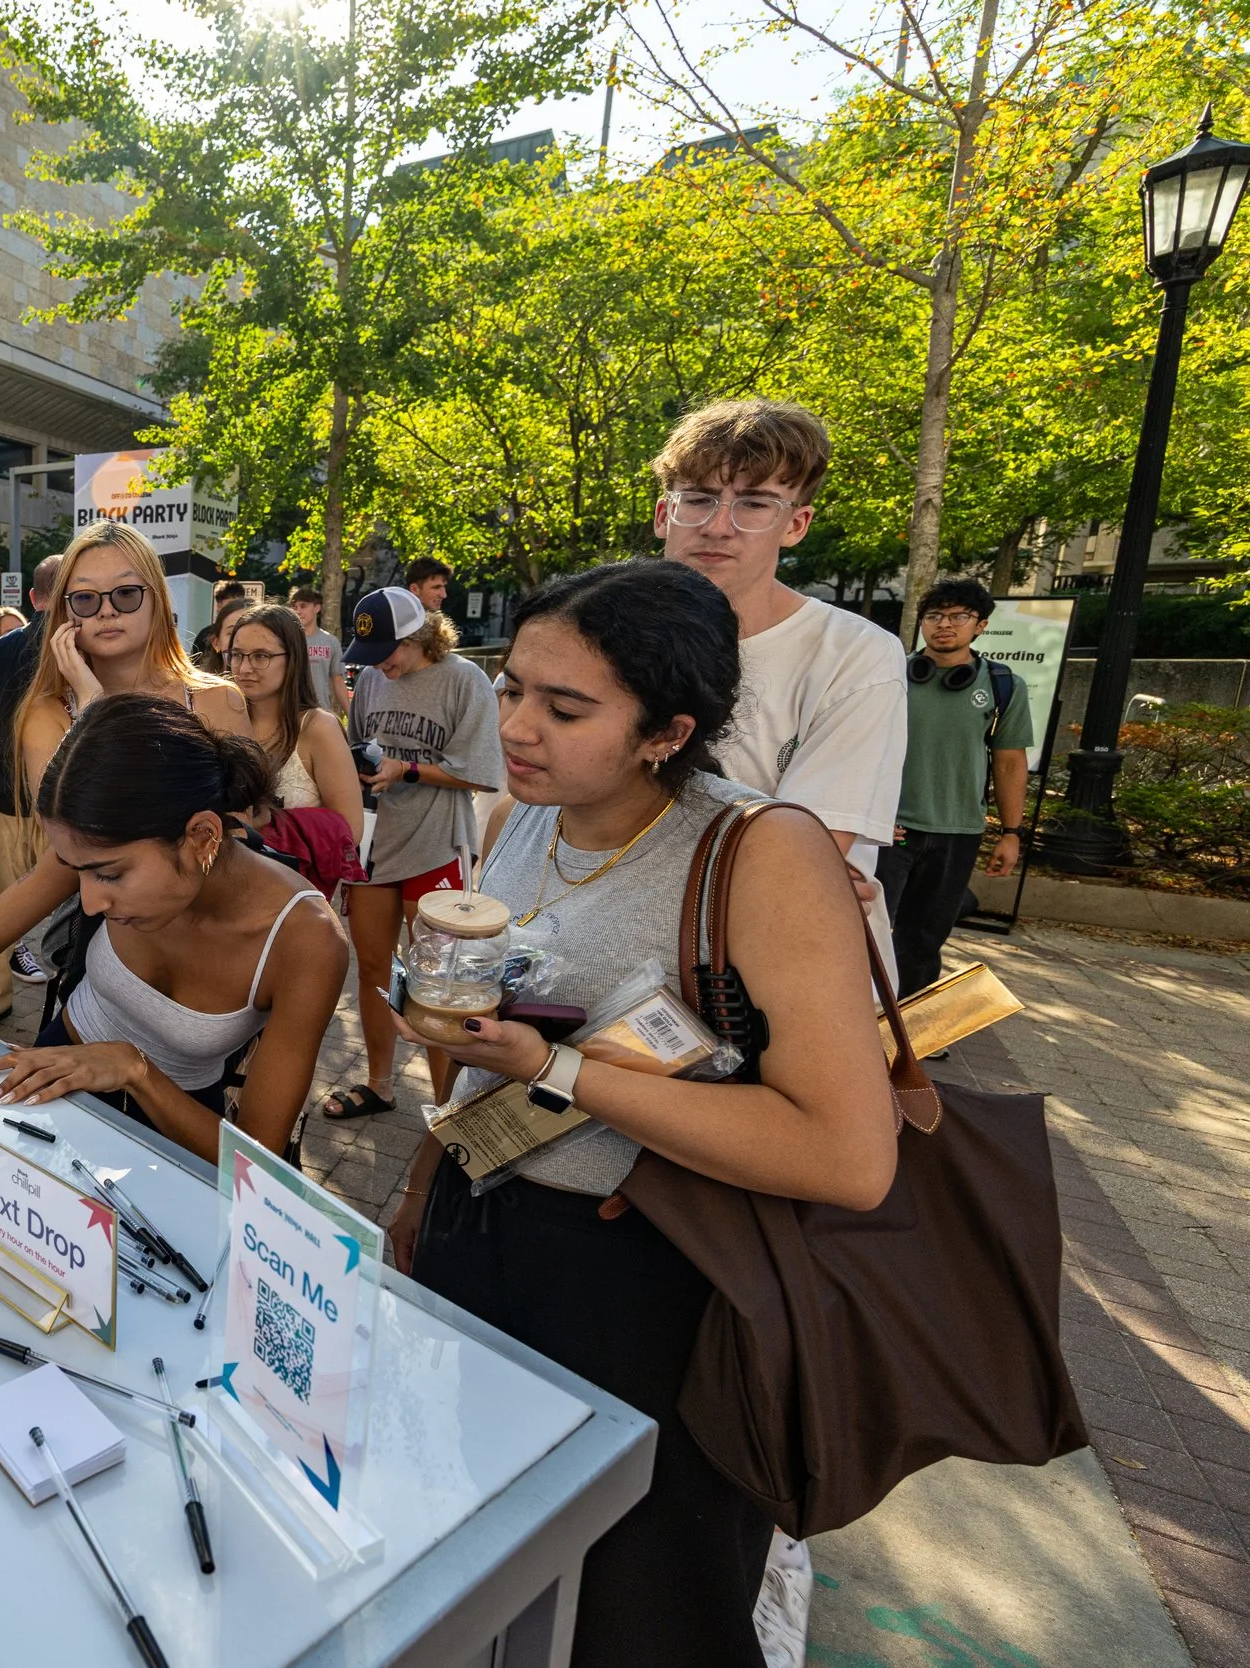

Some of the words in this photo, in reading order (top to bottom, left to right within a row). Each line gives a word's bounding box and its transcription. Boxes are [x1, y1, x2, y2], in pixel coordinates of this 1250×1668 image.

[77, 506, 128, 527] BLOCK
[132, 503, 188, 525] PARTY
[192, 502, 215, 526] BLOCK
[978, 650, 1045, 664] ecording
[383, 711, 446, 752] ENGLAND
[6, 1231, 23, 1248] hour
[23, 1244, 34, 1256] on
[35, 1250, 47, 1266] the
[48, 1259, 66, 1278] hour
[27, 1207, 86, 1269] Drop
[243, 1222, 295, 1287] Scan
[302, 1270, 339, 1323] Me
